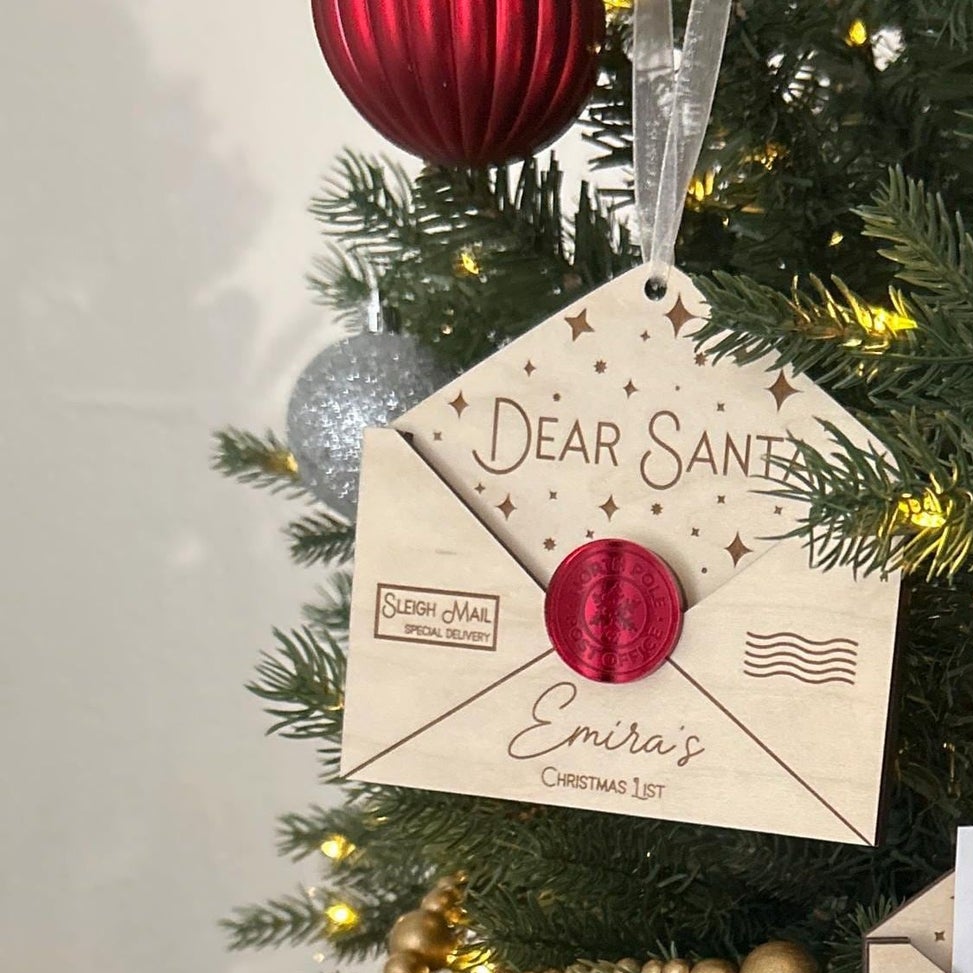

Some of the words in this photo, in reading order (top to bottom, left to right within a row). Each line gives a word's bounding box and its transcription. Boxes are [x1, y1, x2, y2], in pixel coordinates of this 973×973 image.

[471, 396, 622, 475] DEAR
[381, 591, 437, 620] SLEIGH
[441, 599, 493, 625] MAIL
[404, 623, 443, 639] SPECIAL
[445, 627, 492, 643] DELIVERY
[507, 681, 706, 767] Emira's
[541, 765, 628, 795] CHRISTMAS
[631, 776, 667, 801] LIST
